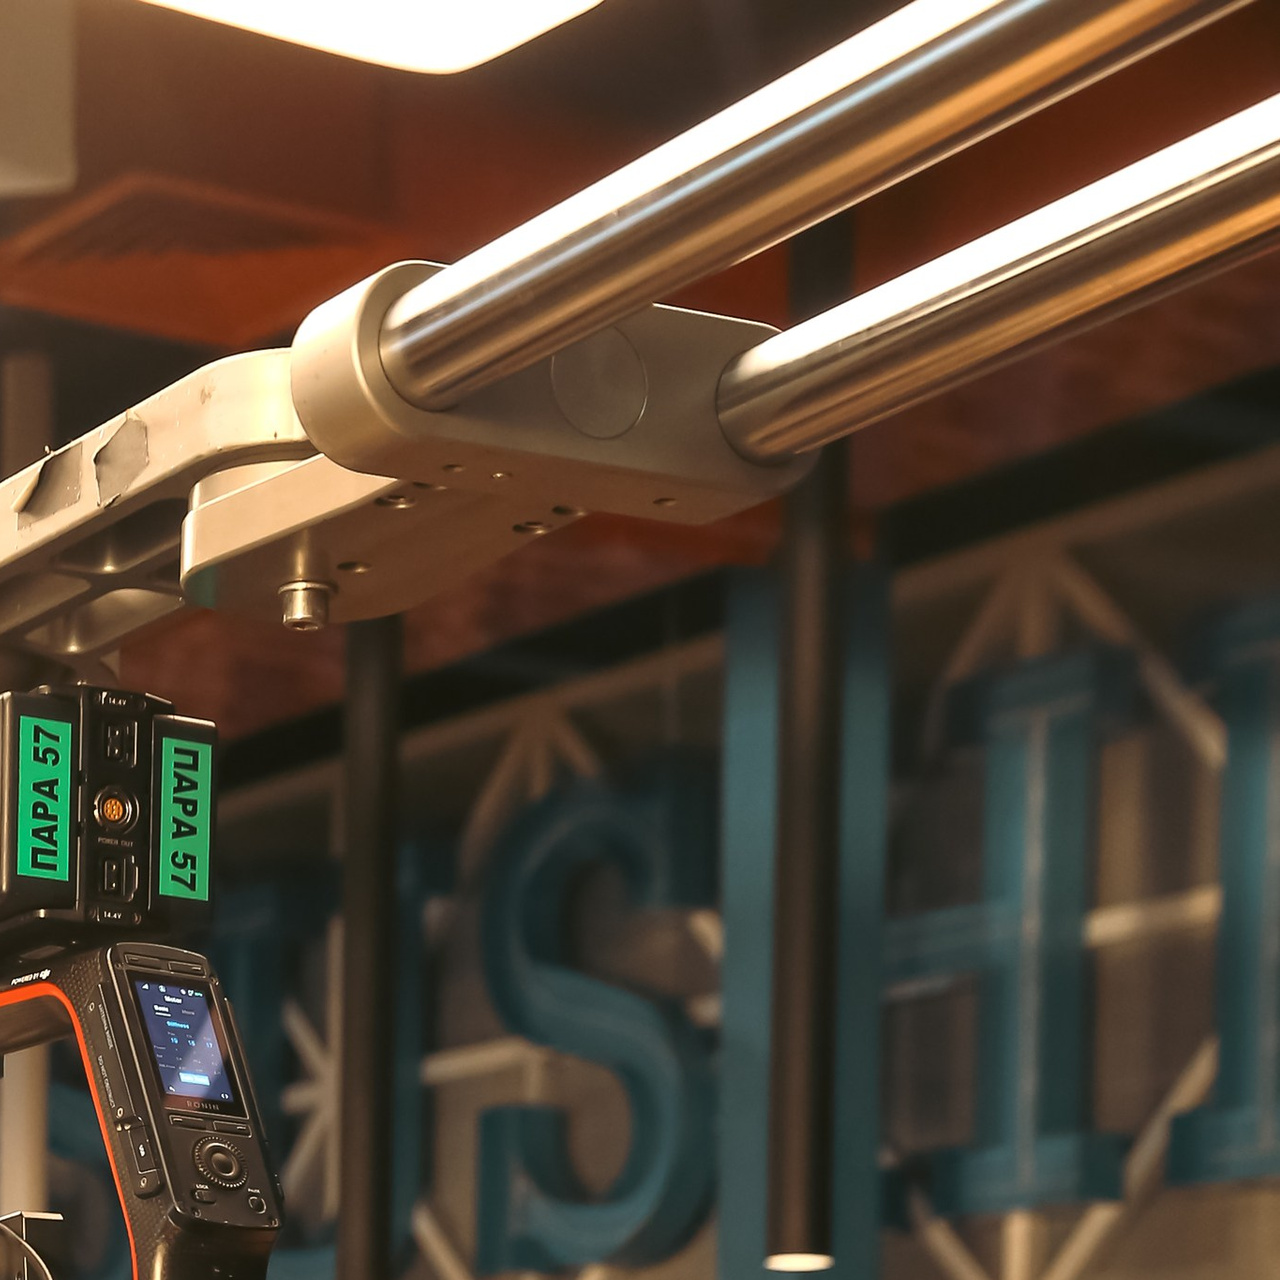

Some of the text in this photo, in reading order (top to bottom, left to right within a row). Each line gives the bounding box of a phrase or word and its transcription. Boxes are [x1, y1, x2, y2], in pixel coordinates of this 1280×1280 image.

[31, 724, 60, 872] ПАРА 57
[170, 746, 199, 892] ПАРА 57
